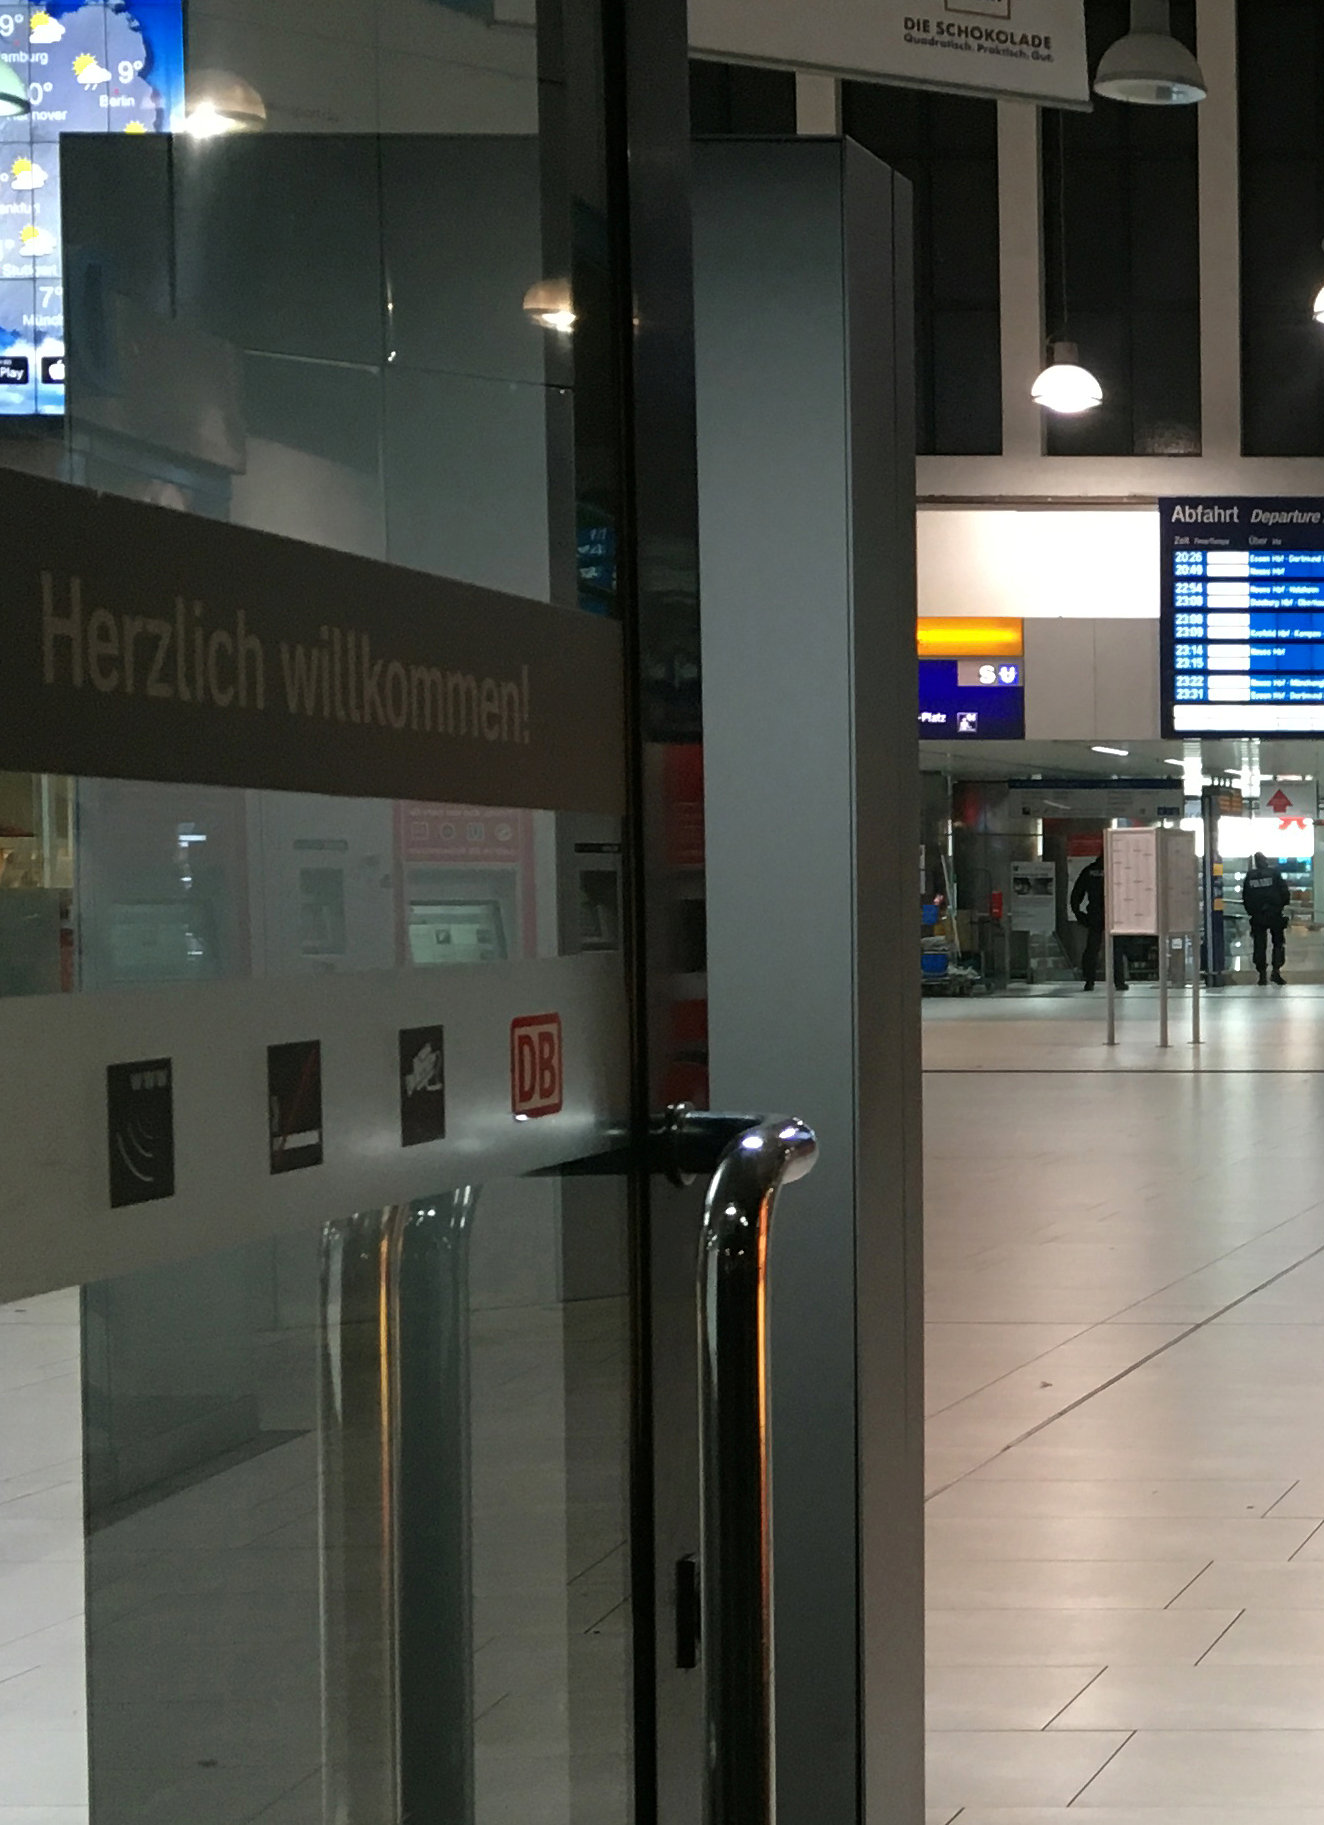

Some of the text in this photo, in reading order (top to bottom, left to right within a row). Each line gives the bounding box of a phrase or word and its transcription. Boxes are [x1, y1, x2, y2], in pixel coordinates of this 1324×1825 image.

[903, 33, 1054, 62] Quadratisch. Praktisch. Gut.
[904, 17, 1052, 50] DIE SCHOKOLADE
[0, 52, 48, 65] amburg
[99, 94, 135, 108] Berlin
[1171, 505, 1239, 523] Abfahrt
[1250, 509, 1321, 525] Departure
[40, 570, 531, 744] Herzlich willkommen!
[516, 1031, 558, 1104] DB
